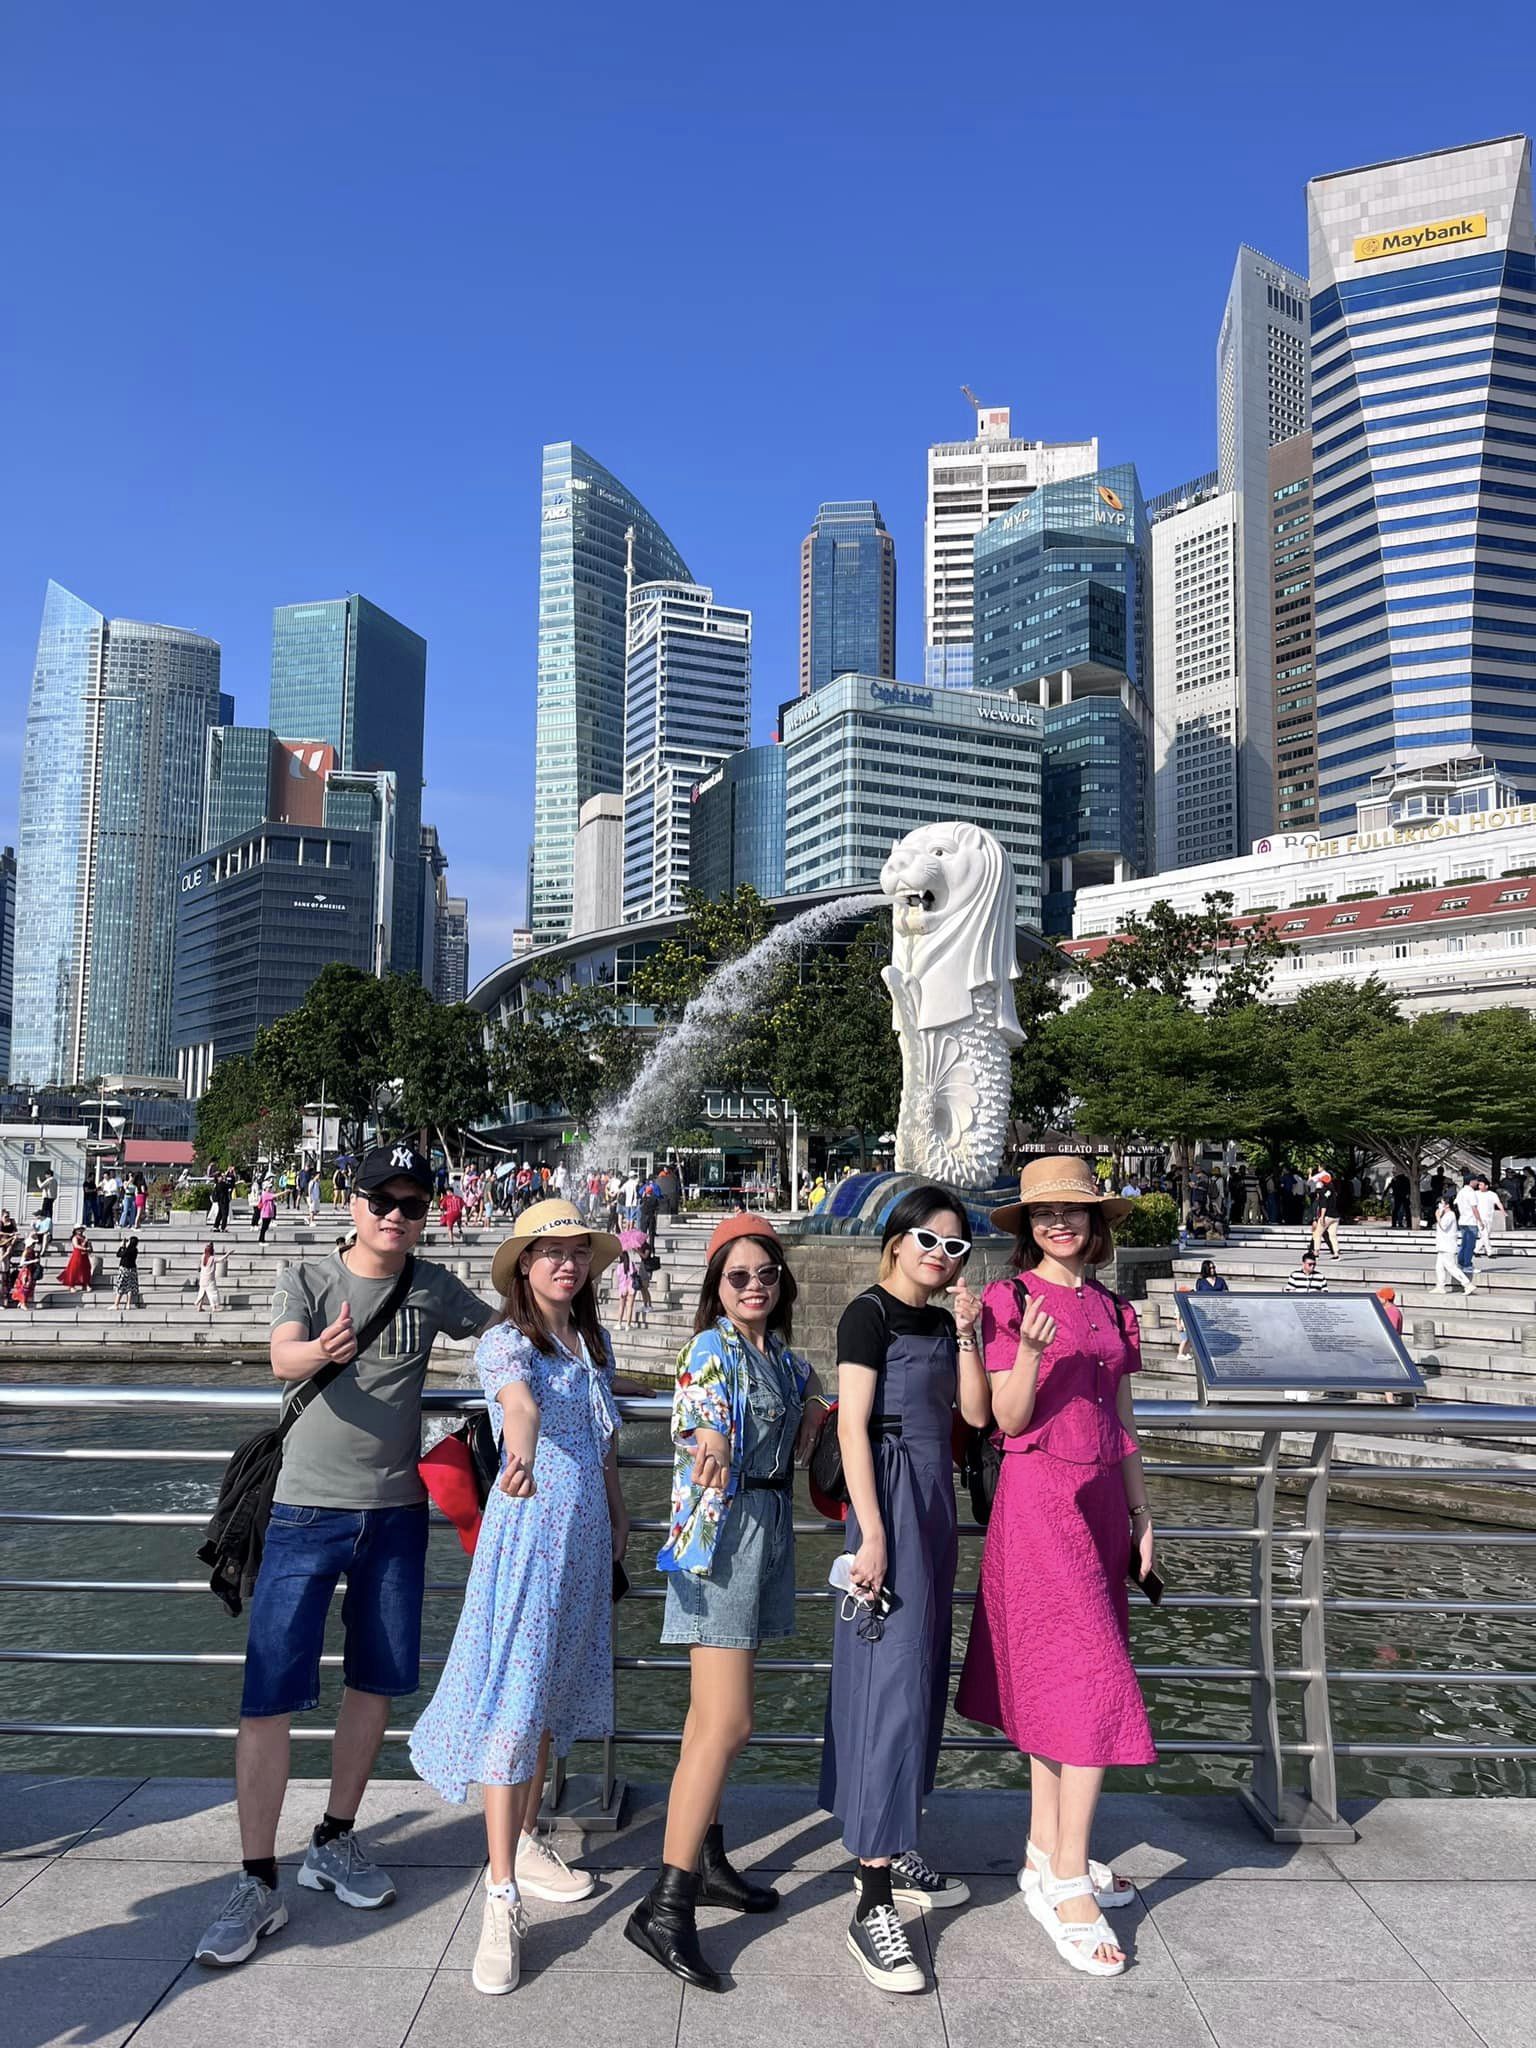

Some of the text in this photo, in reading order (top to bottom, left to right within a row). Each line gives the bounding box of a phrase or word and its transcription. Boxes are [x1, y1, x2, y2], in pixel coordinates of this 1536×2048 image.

[1382, 220, 1474, 251] Maybank
[1003, 508, 1030, 531] MYP
[1094, 510, 1126, 526] MYP
[976, 707, 1036, 726] wework
[1304, 804, 1536, 859] THE FULLERTON HOTE
[320, 903, 347, 911] AMERICA
[701, 1095, 791, 1120] ULLERT
[389, 1146, 414, 1170] NY
[1058, 1144, 1092, 1154] GELATO
